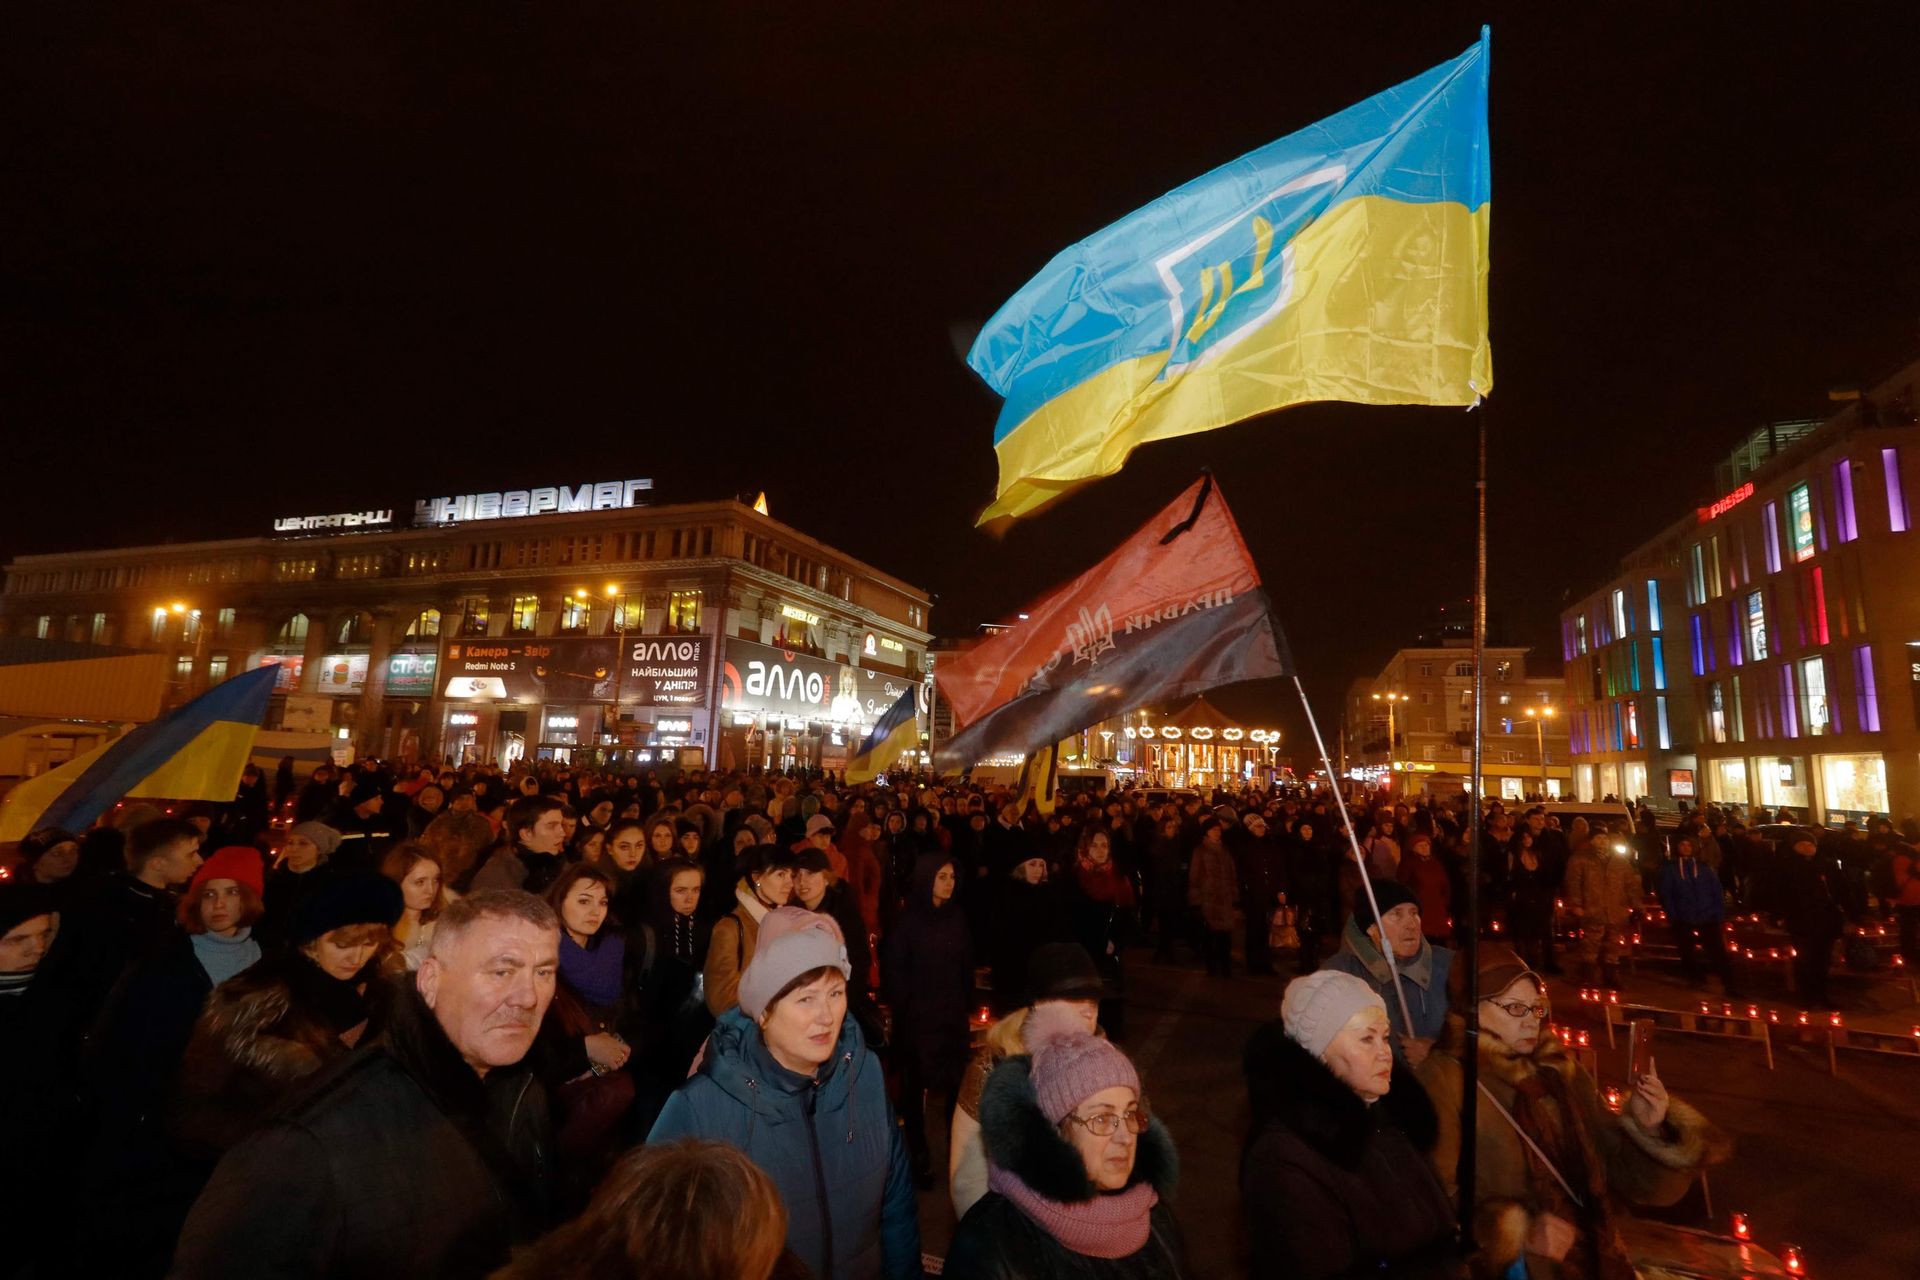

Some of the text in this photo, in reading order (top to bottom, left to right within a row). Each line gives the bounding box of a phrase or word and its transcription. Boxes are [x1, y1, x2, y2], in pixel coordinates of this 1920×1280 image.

[466, 646, 509, 659] Камера
[524, 646, 551, 659] Звір
[465, 662, 516, 671] Redmi Note 5
[631, 667, 698, 677] НАЙБІЛЬШИЙ
[655, 681, 697, 691] У ДНІПРІ
